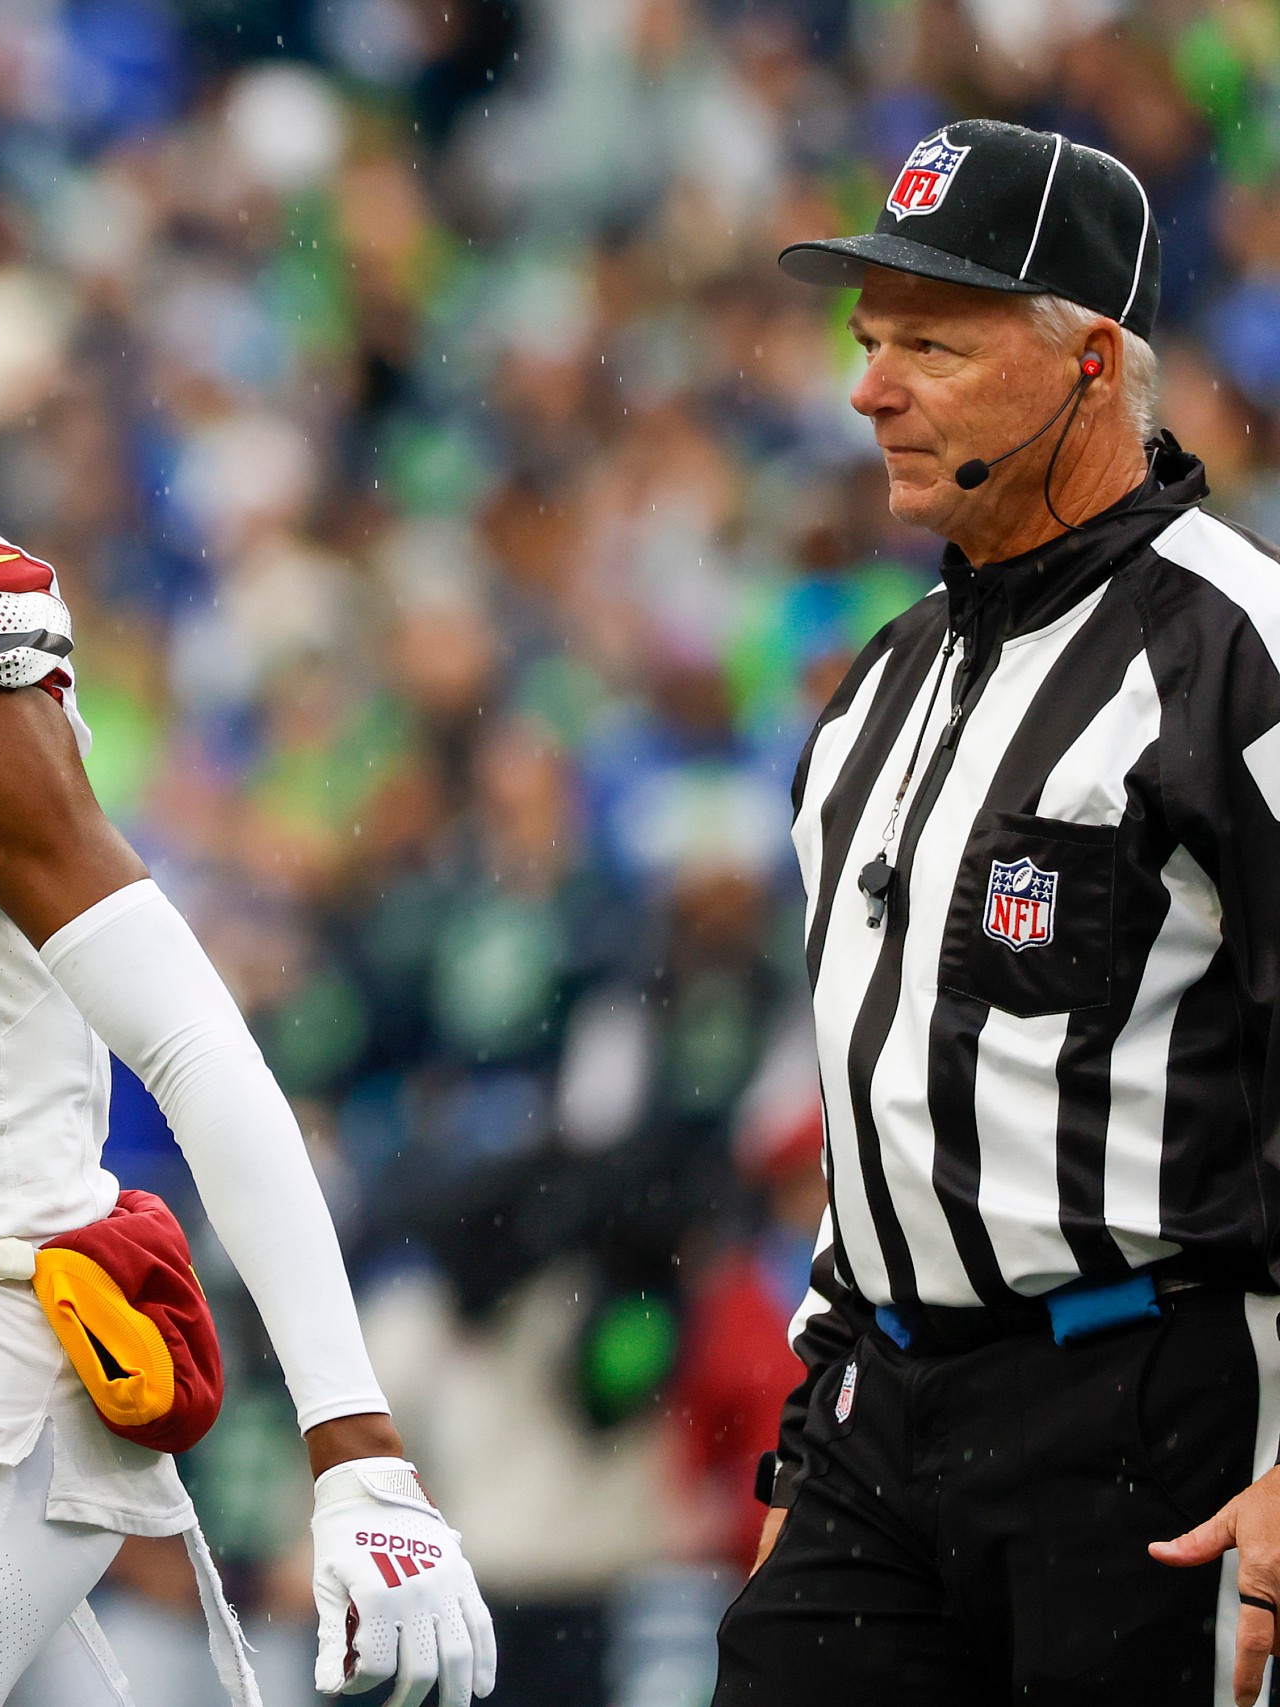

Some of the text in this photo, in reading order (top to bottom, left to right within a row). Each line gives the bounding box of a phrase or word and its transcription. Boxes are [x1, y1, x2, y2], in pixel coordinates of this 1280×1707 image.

[891, 168, 940, 209] NFL
[991, 894, 1046, 942] NFL
[355, 1531, 442, 1559] adidas
